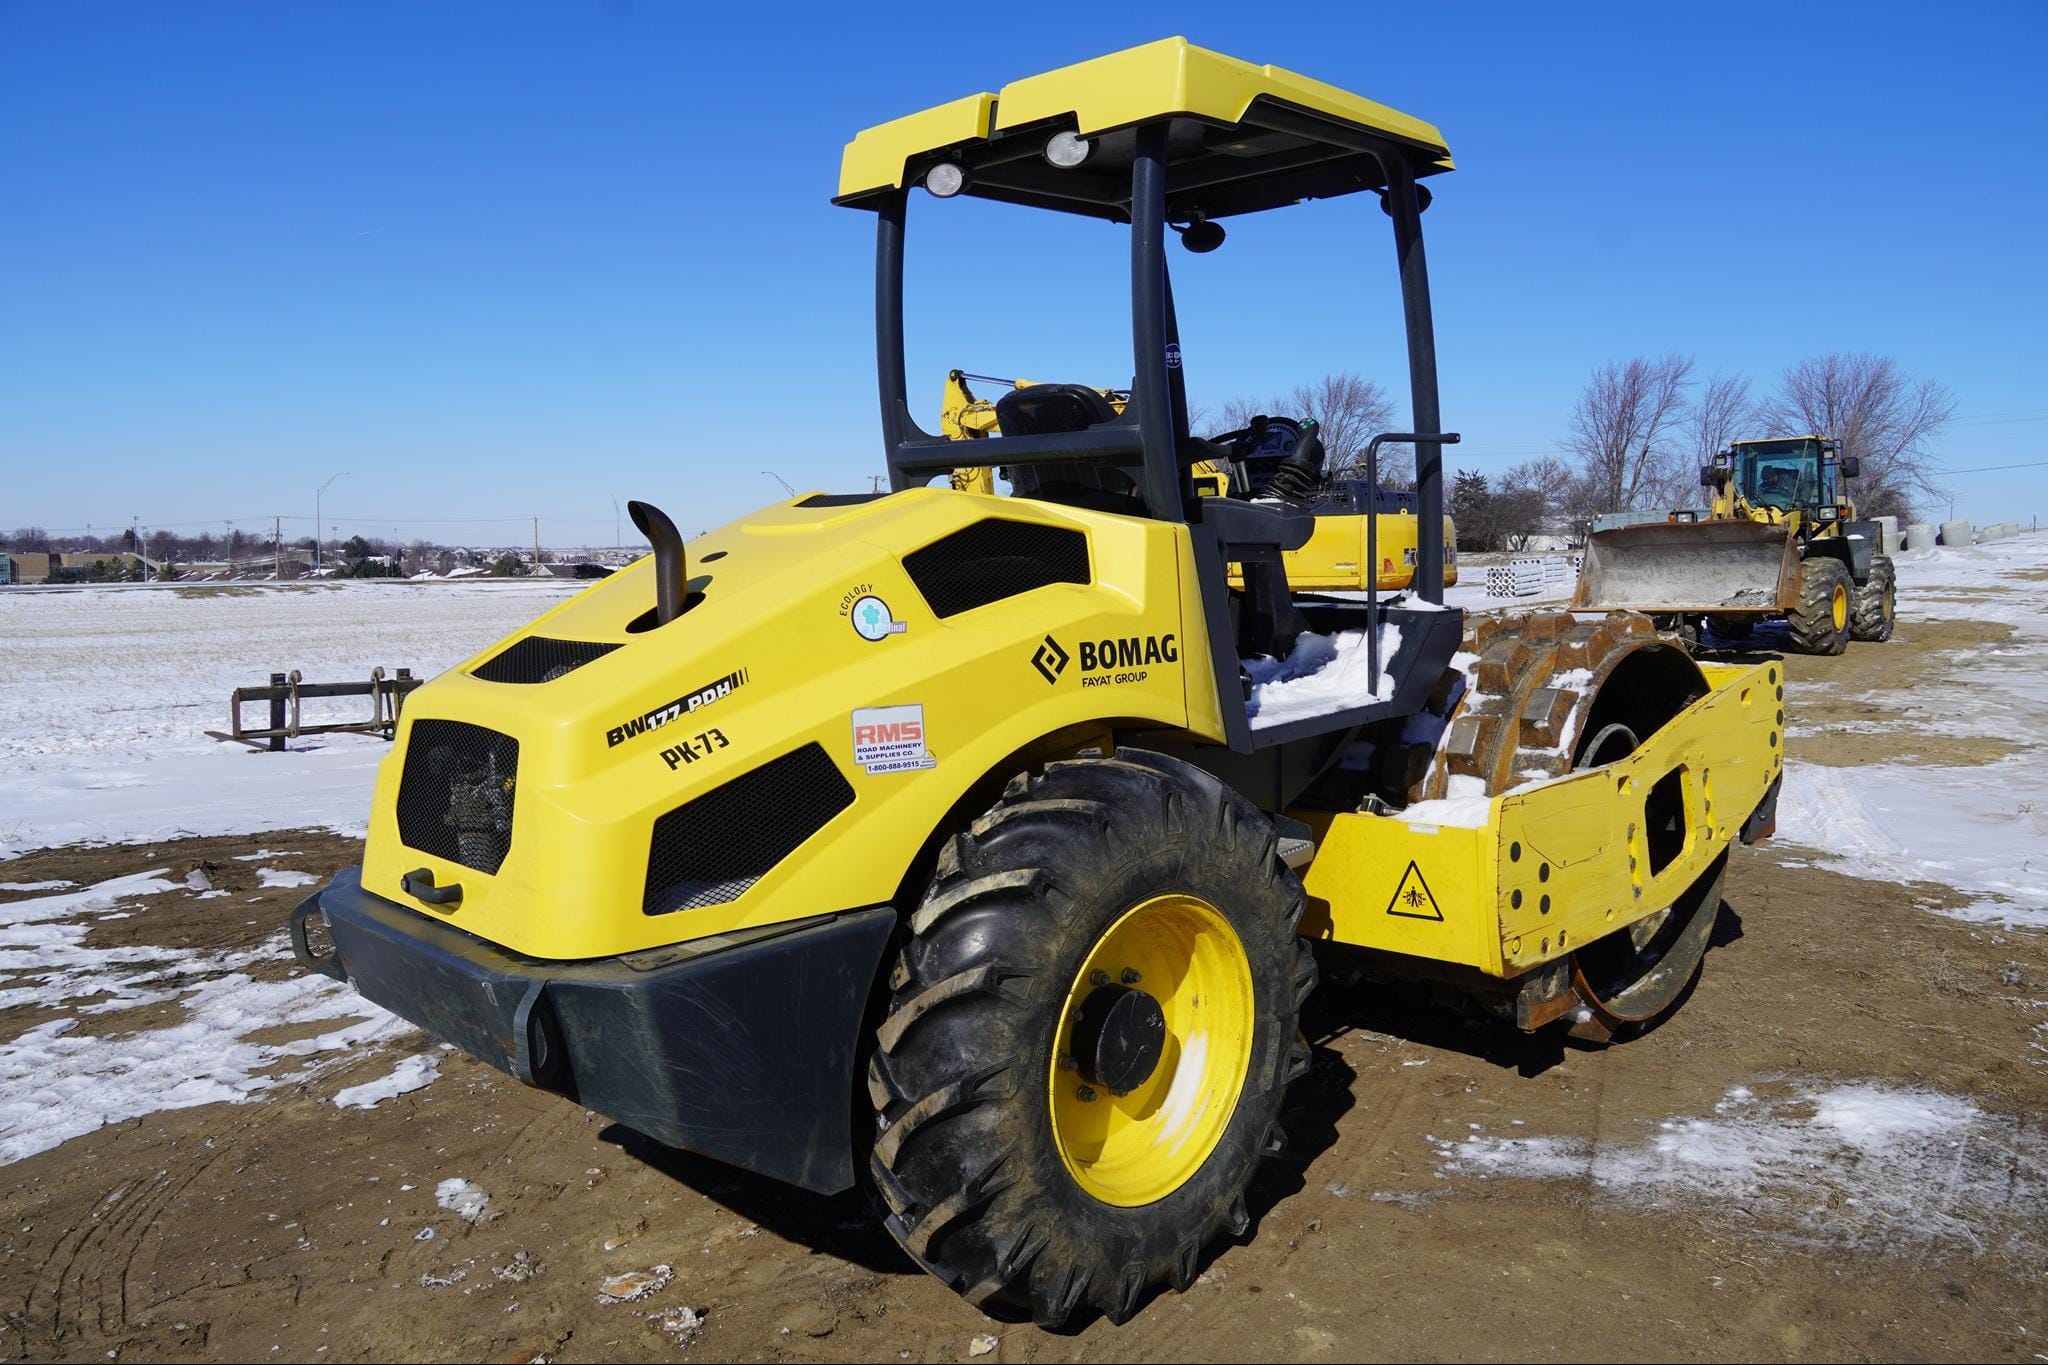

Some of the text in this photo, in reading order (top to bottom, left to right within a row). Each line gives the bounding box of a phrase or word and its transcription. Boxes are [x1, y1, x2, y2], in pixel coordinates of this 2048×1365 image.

[840, 584, 873, 617] ECOLOGY
[1079, 633, 1178, 672] BOMAG
[1082, 671, 1148, 688] FAYAT GROUP
[687, 680, 732, 713] PDH
[855, 721, 922, 746] RMS
[659, 728, 730, 771] PK-73
[865, 751, 901, 760] SUPPLIES
[879, 742, 922, 752] MACHINERY
[868, 760, 920, 772] 1-800-888-9515
